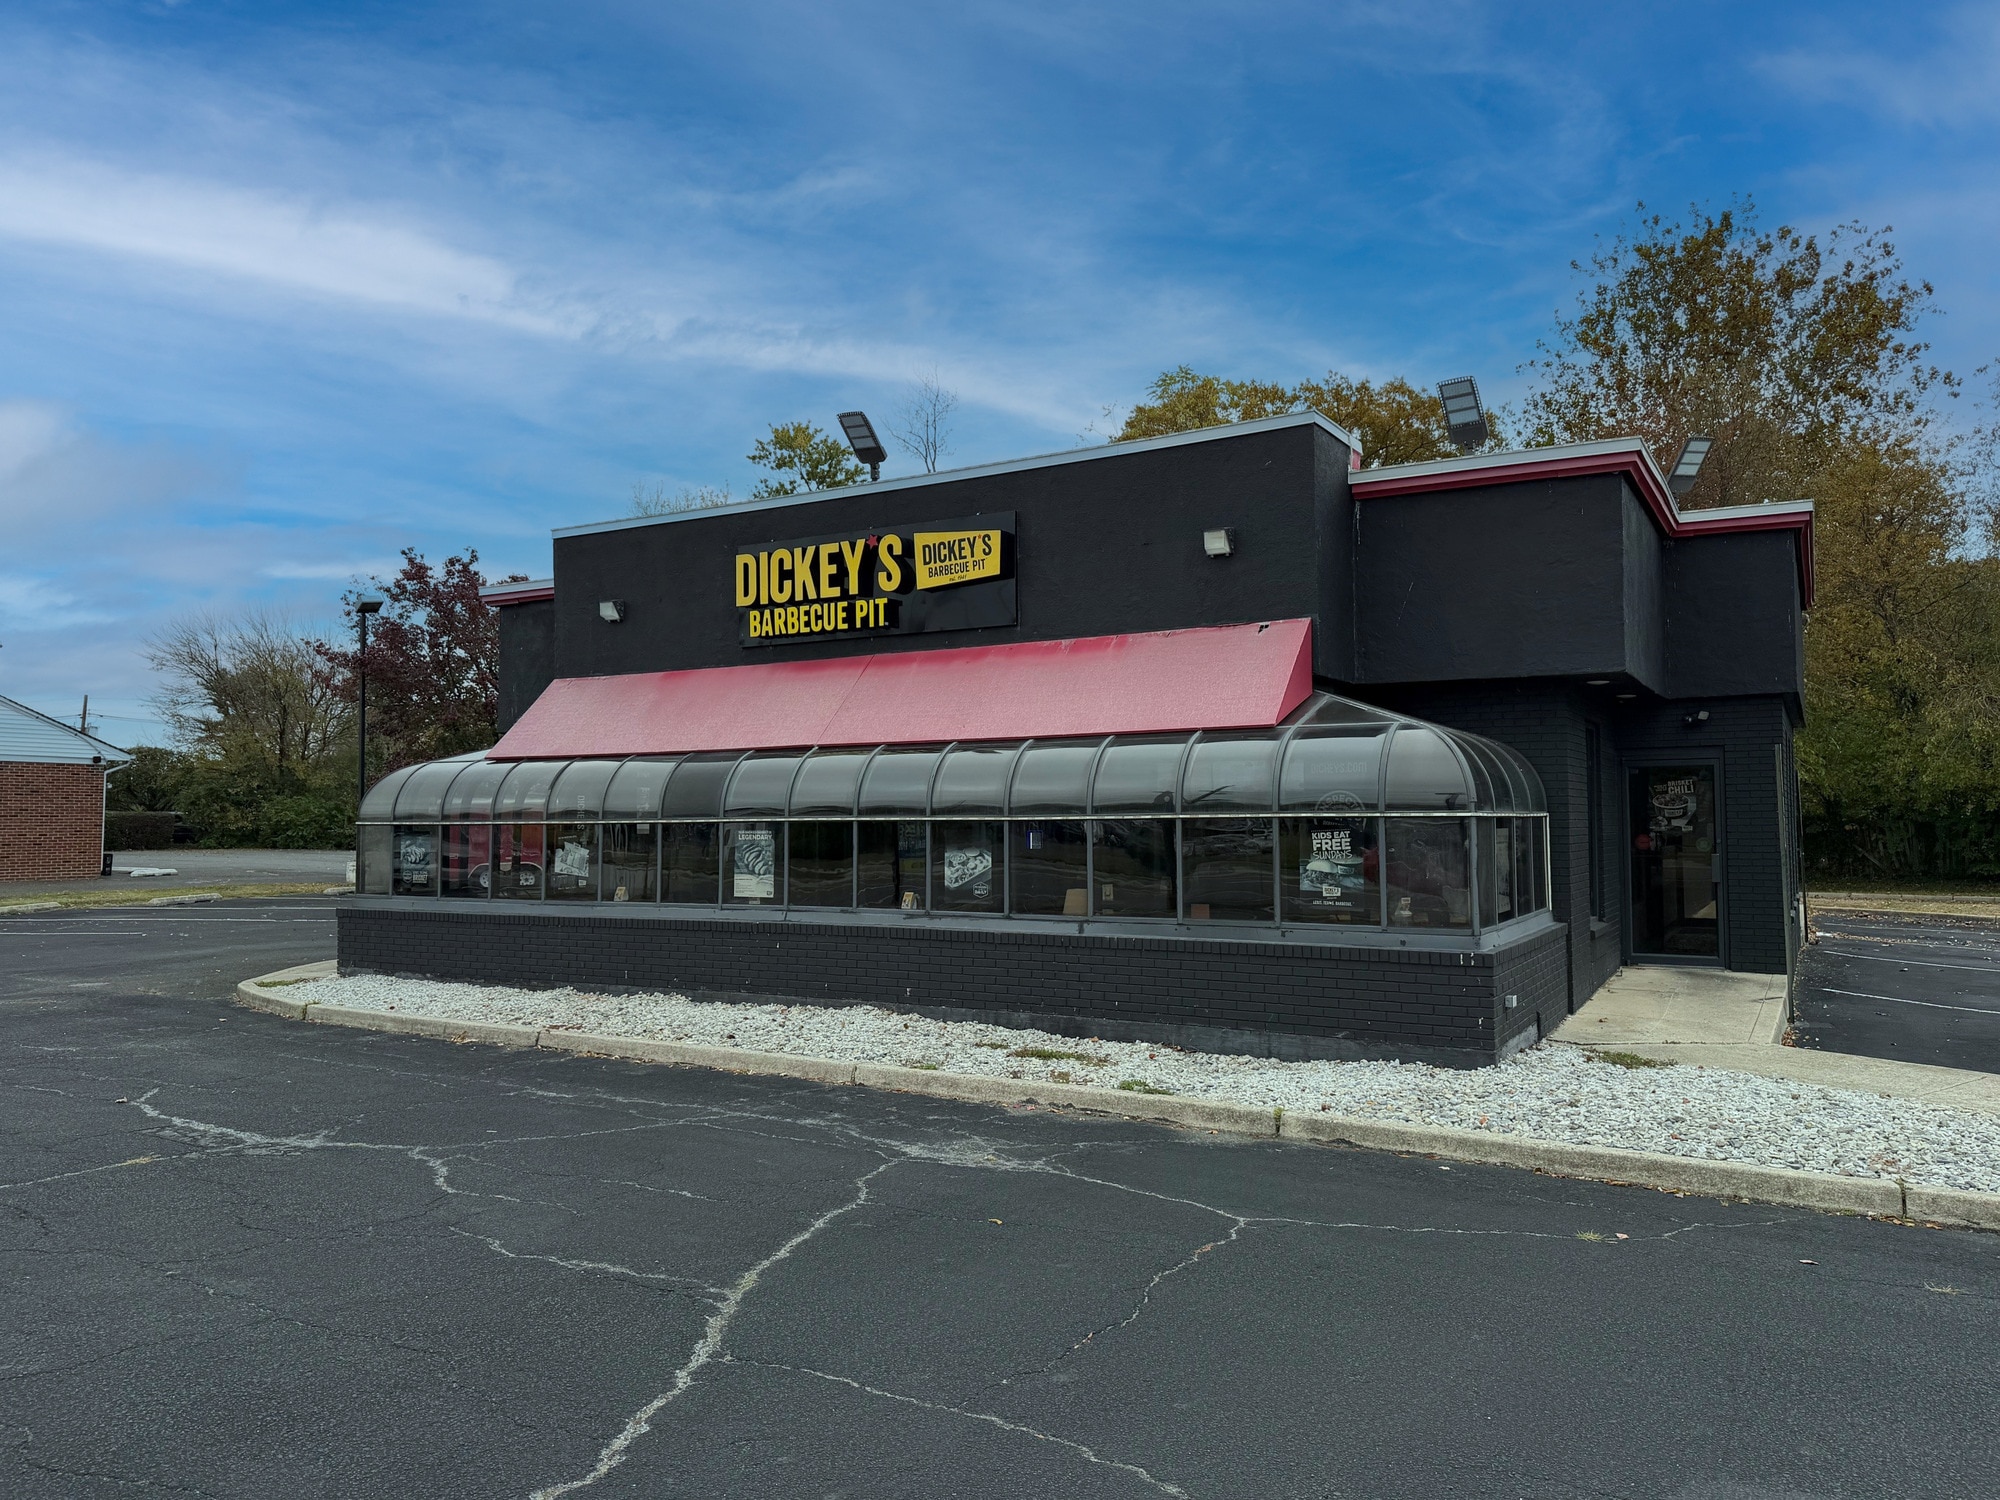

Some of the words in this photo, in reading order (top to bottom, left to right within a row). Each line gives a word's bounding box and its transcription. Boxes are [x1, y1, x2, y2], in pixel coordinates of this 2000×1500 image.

[922, 533, 992, 566] DICKEY'S
[735, 533, 903, 607] DICKEY'S
[928, 561, 970, 578] BARBECUE
[972, 558, 986, 571] PIT
[749, 601, 849, 637] BARBECUE
[855, 597, 888, 628] PIT
[1668, 785, 1695, 794] CHILI
[1311, 832, 1332, 840] KIDS
[1333, 831, 1351, 839] EAT
[1312, 838, 1352, 851] FREE
[1312, 850, 1353, 860] SUNDAYS
